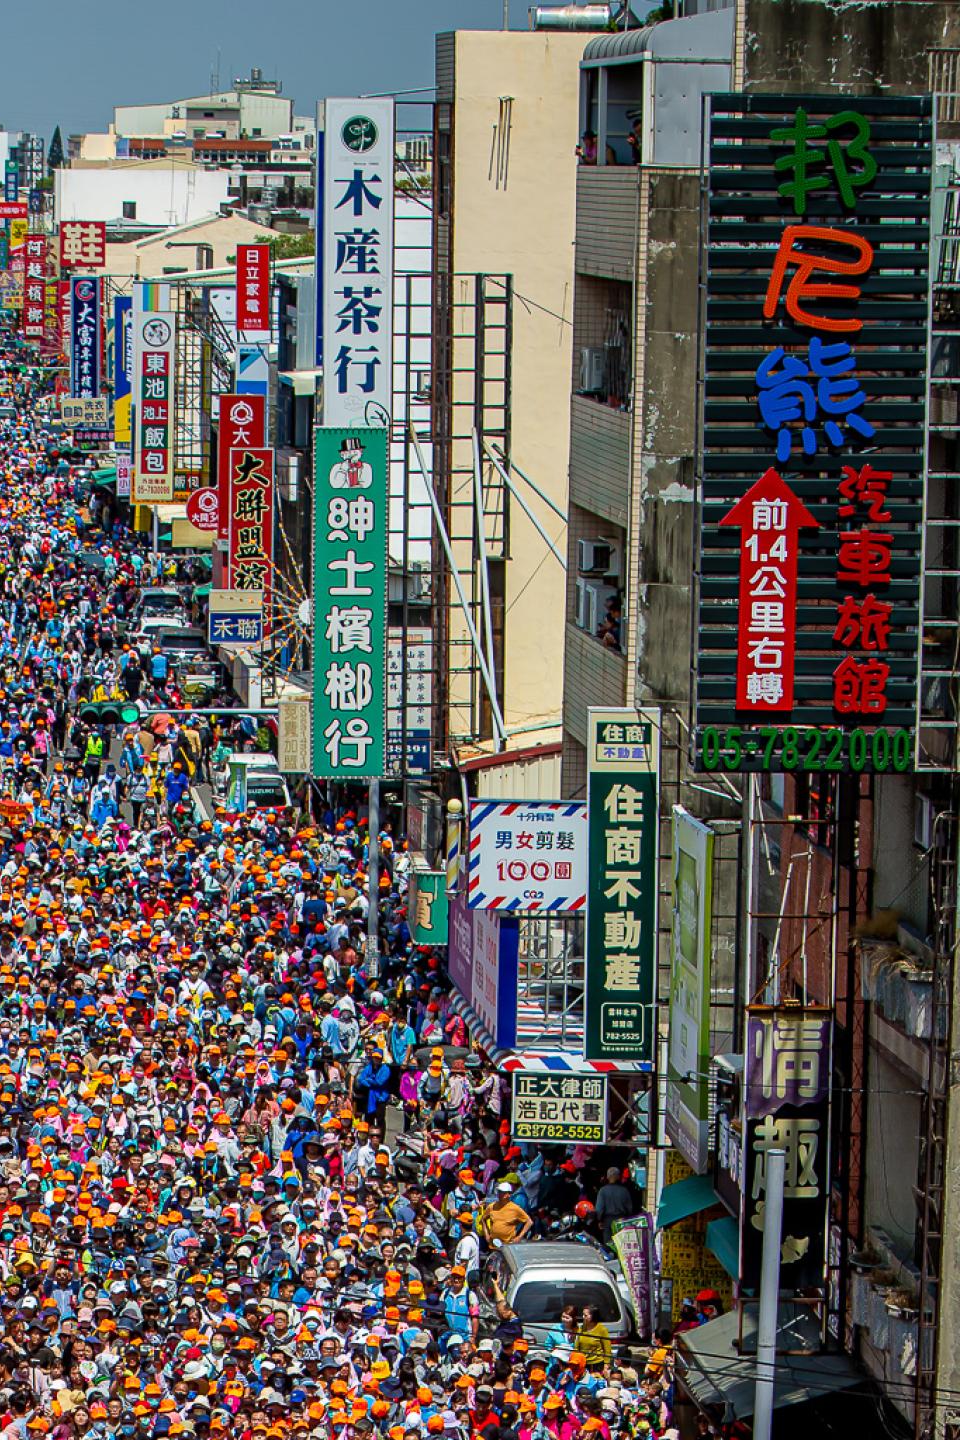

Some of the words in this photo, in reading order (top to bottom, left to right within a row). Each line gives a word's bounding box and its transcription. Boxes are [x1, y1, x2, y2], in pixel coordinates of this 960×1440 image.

[62, 224, 102, 263] 鞋
[245, 250, 260, 313] 日立家電
[756, 108, 876, 461] 邦尼熊
[234, 451, 270, 589] 大聯盟檳
[833, 464, 892, 714] 汽車旅館
[213, 618, 258, 639] 禾聯
[324, 495, 374, 768] 紳士檳榔行
[603, 724, 645, 742] 住商
[702, 727, 910, 770] 05-7822000
[495, 831, 575, 850] 男女剪髮
[517, 1077, 601, 1098] 正大律師
[518, 1100, 600, 1121] 浩記代書
